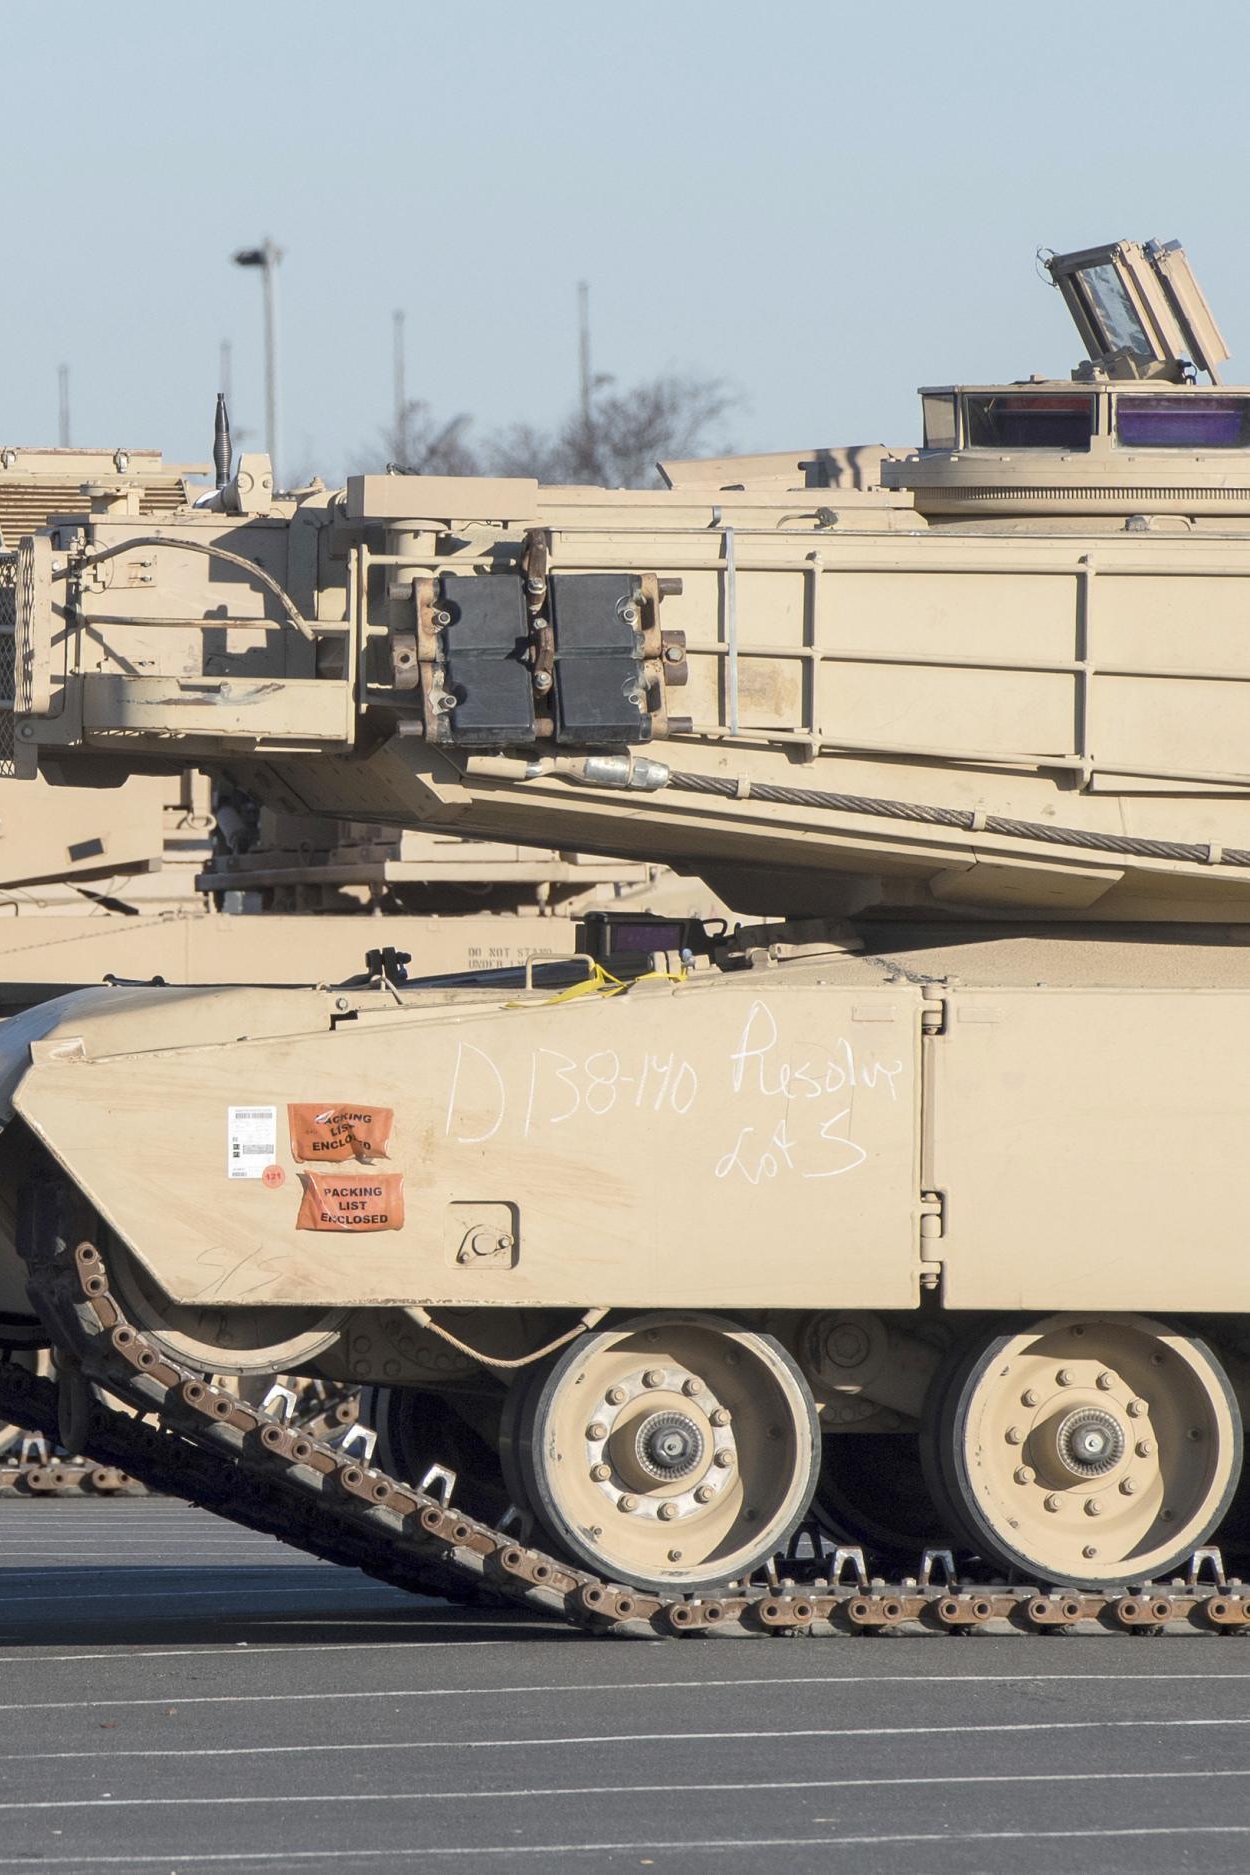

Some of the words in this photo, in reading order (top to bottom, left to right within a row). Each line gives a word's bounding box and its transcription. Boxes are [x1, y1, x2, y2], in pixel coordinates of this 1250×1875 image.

[468, 947, 482, 958] DO
[489, 947, 510, 958] NOT
[316, 1112, 373, 1125] ACKING
[312, 1134, 372, 1152] ENCLOD
[324, 1187, 383, 1197] PACKING
[339, 1201, 367, 1211] LIST
[320, 1212, 389, 1225] ENCLOSED
